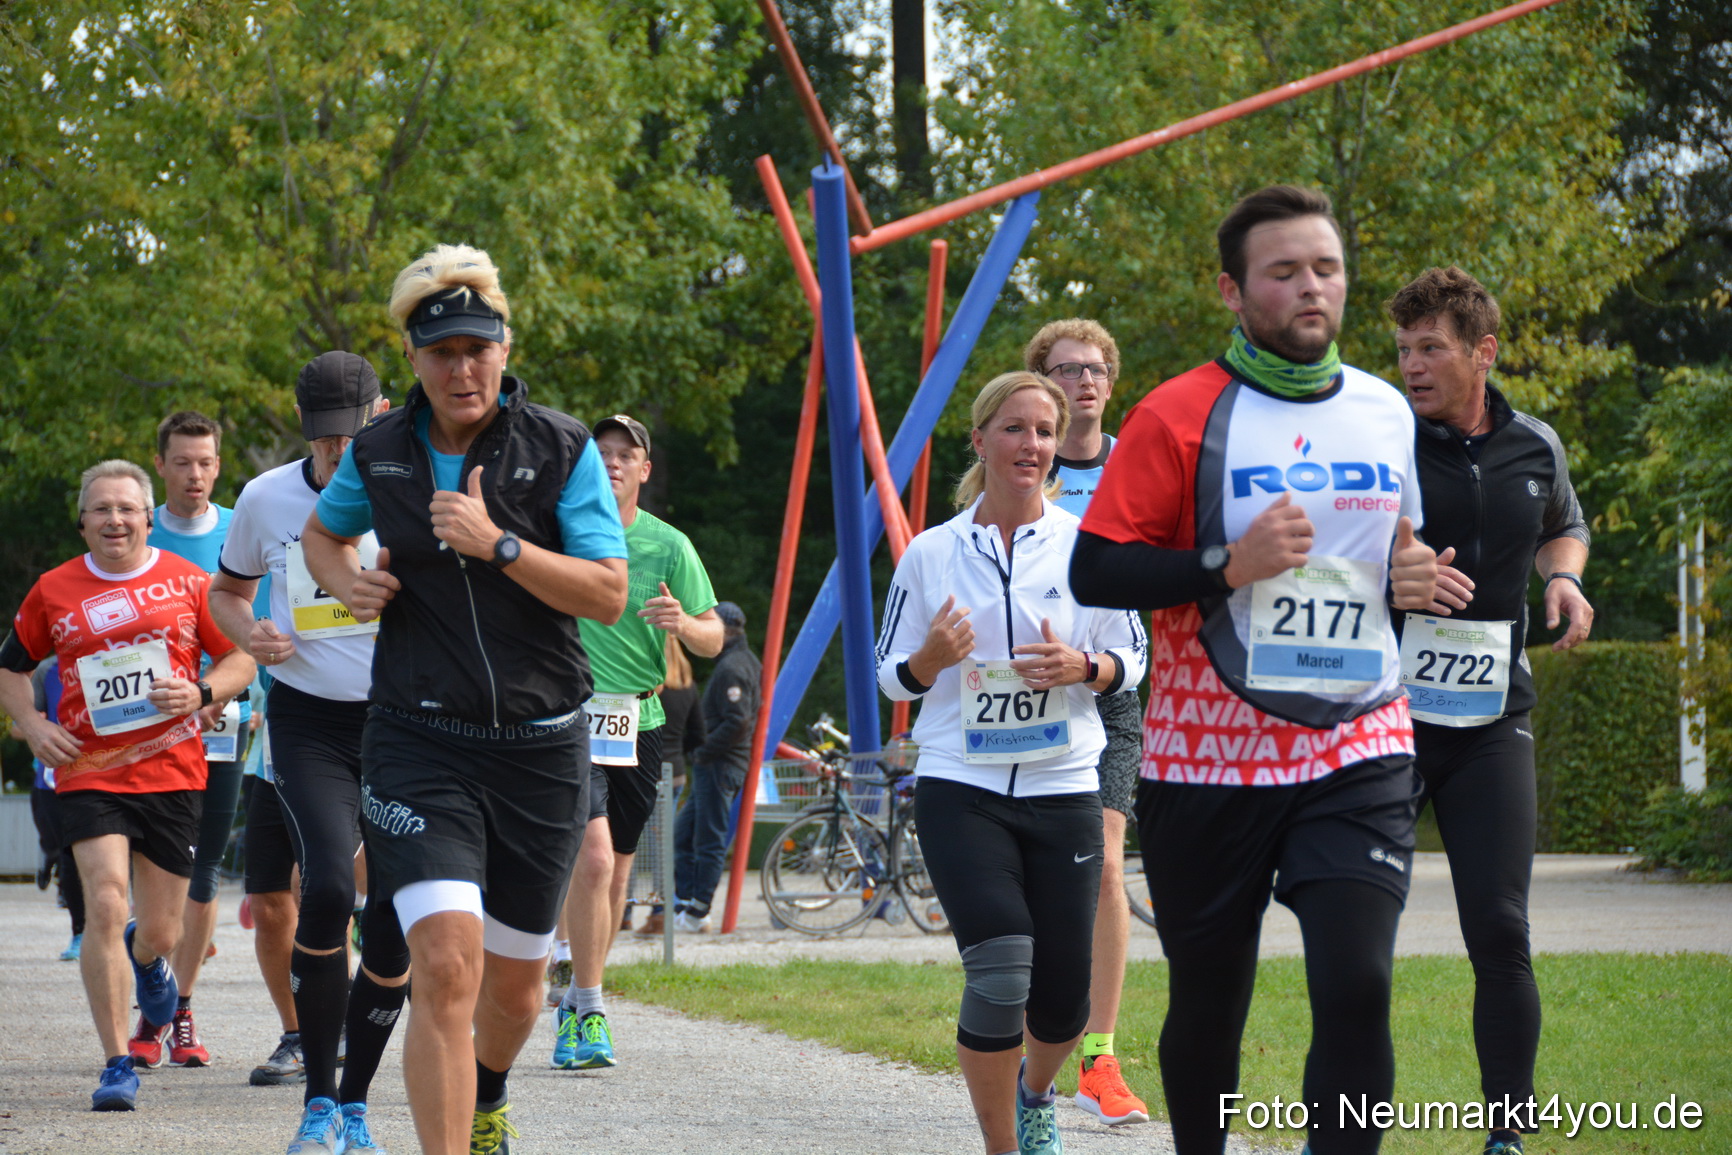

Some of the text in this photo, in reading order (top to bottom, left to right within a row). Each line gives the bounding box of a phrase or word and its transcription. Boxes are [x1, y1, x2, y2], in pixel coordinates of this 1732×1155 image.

[84, 591, 125, 610] raumbox
[333, 608, 353, 619] Uw
[1272, 597, 1366, 639] 2177
[1447, 629, 1485, 641] BOCK
[1297, 653, 1343, 669] Marcel
[1415, 650, 1495, 685] 2722
[997, 670, 1022, 679] BO
[976, 689, 1050, 723] 2767
[1411, 688, 1467, 708] Börni
[122, 706, 146, 716] Hans
[138, 725, 190, 754] raumbox
[986, 732, 1043, 748] Kristina
